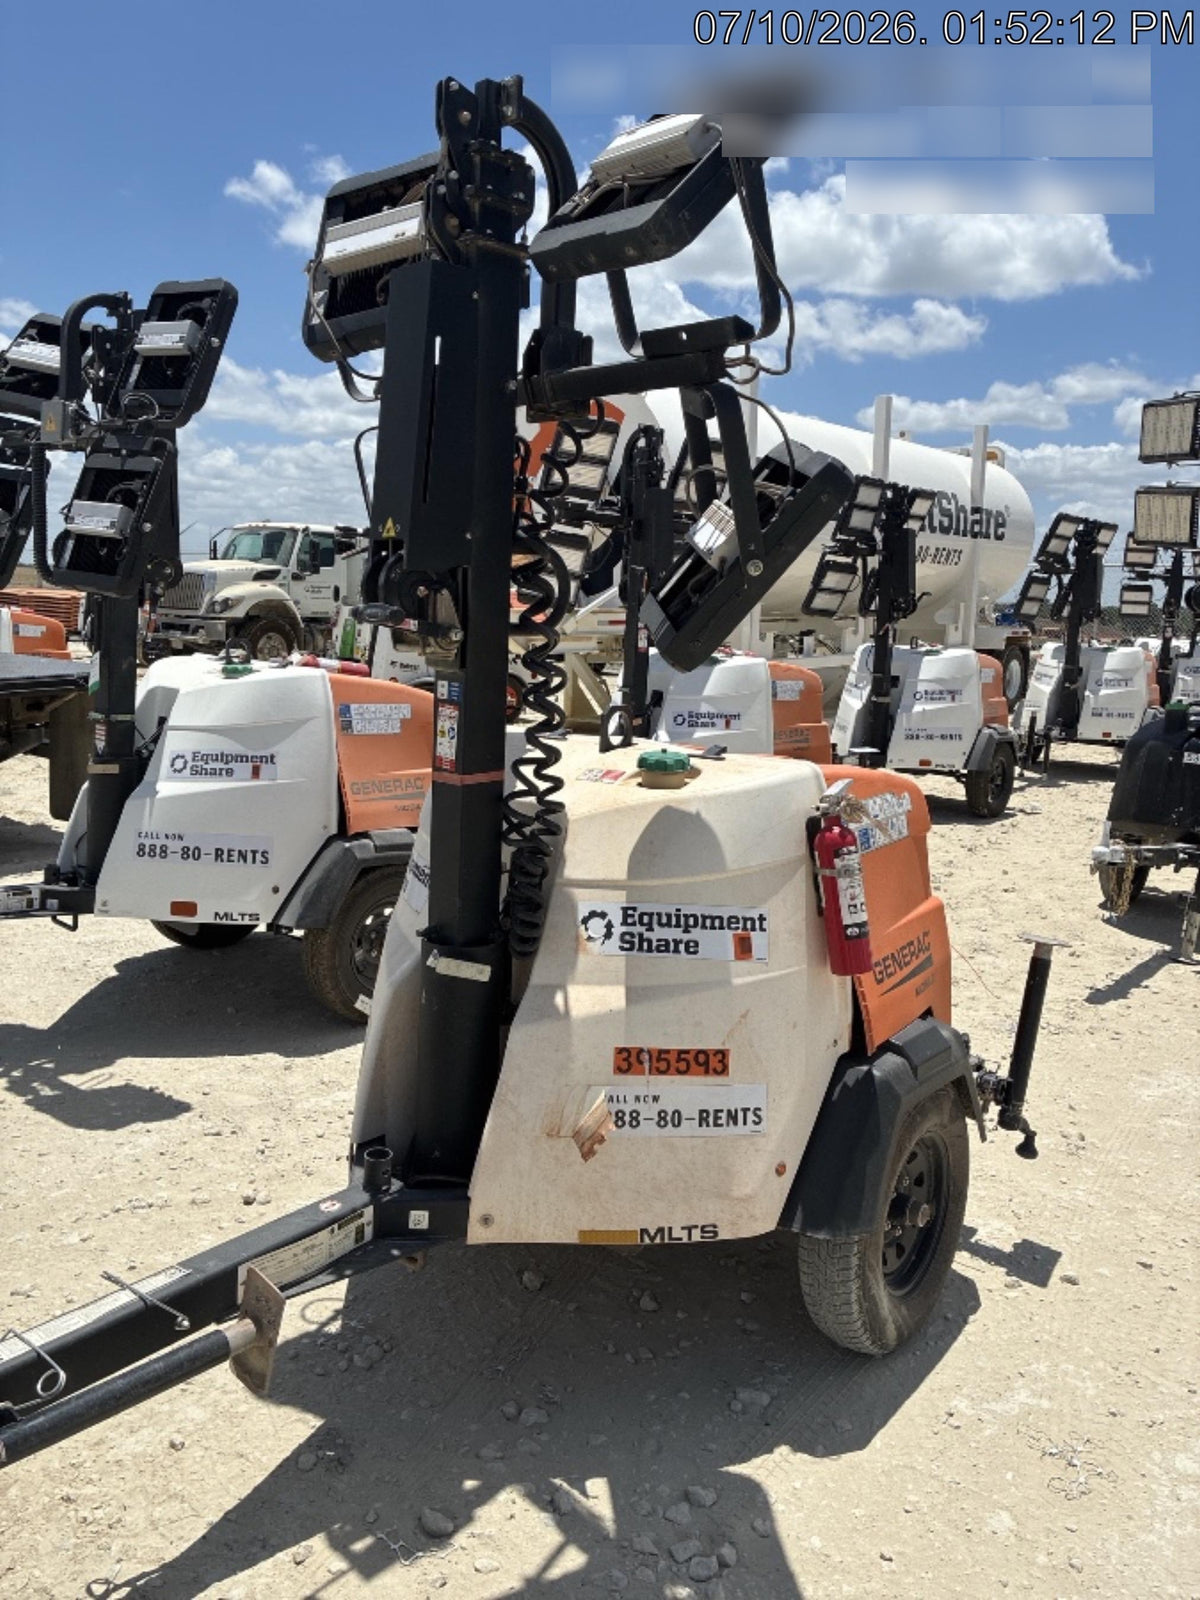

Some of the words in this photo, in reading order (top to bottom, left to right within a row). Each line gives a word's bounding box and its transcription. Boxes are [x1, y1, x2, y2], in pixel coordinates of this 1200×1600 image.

[191, 751, 276, 766] Equipment
[189, 763, 235, 778] Share
[349, 776, 425, 796] GENERAC
[137, 831, 161, 841] CALL
[136, 842, 270, 866] 888-80-RENTS
[214, 911, 260, 922] MLTS
[619, 906, 767, 934] Equipment
[618, 931, 700, 955] Share
[872, 930, 931, 986] GENERAC
[615, 1047, 728, 1076] 395593
[604, 1094, 628, 1104] ALL
[634, 1094, 661, 1104] NOW
[609, 1107, 763, 1130] 88-80-RENTS
[639, 1223, 719, 1243] MLTS
